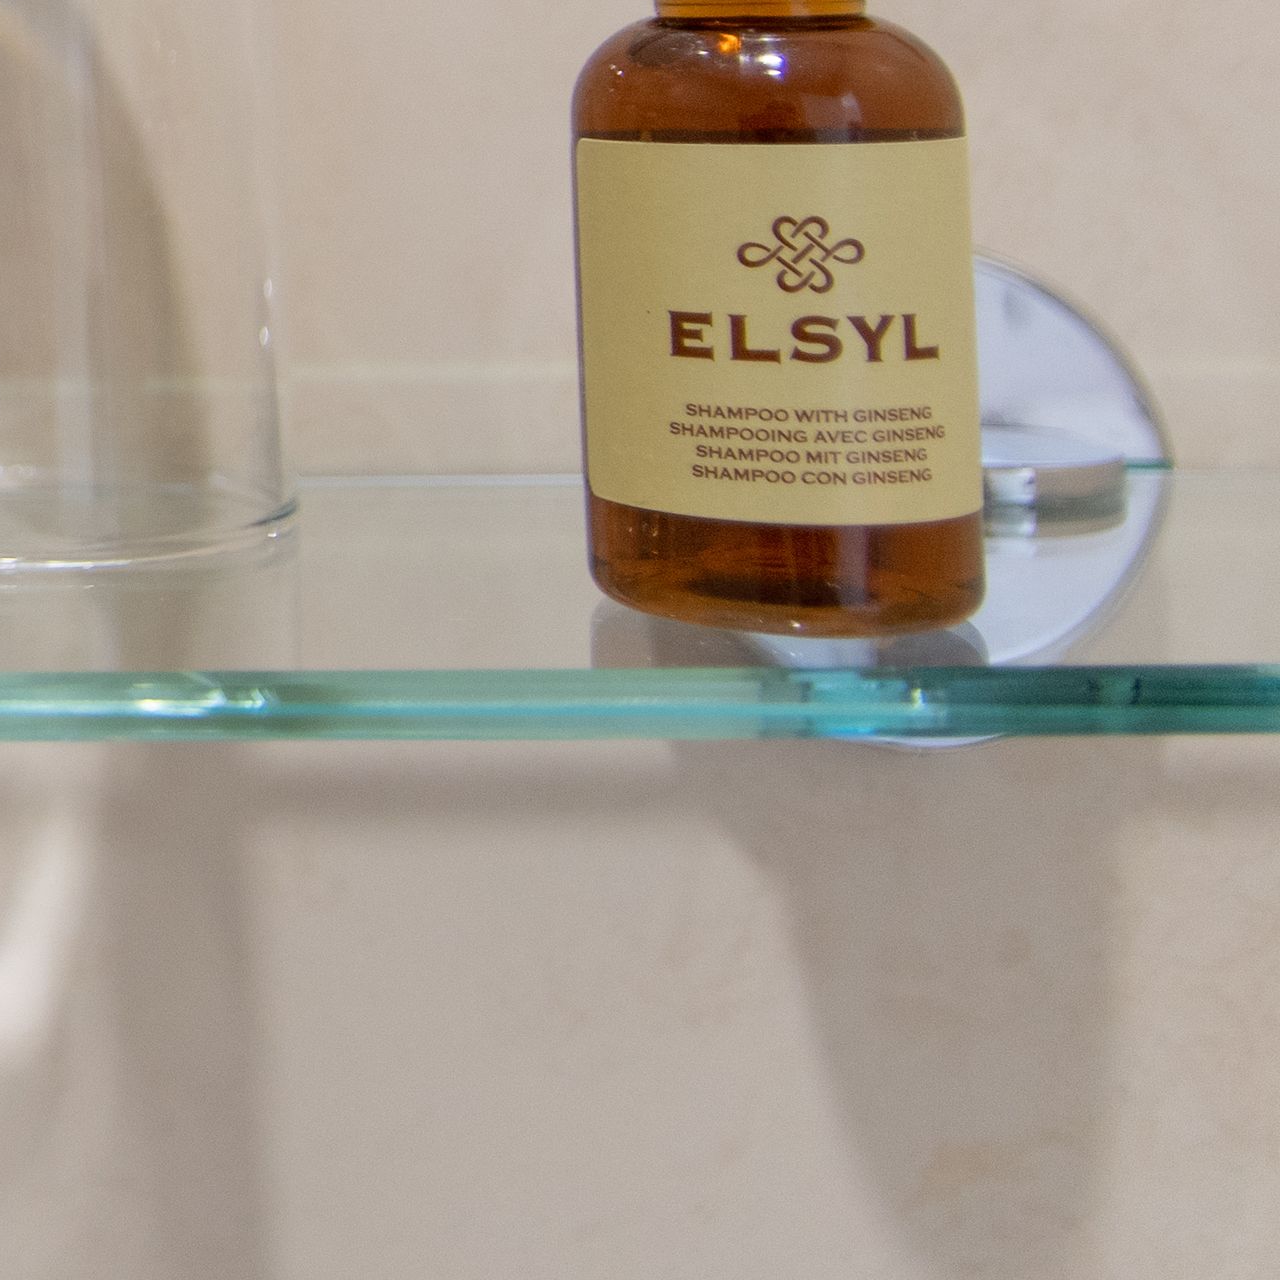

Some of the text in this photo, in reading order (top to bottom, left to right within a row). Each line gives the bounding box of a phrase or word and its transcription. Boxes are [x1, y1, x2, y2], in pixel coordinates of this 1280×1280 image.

[668, 310, 940, 364] ELSYL
[686, 403, 932, 423] SHAMPOO WITH GINSENG
[669, 422, 945, 443] SHAMPOOING AVEC GINSENG
[696, 445, 927, 464] SHAMPOO MIT GINSENG
[692, 465, 932, 484] SHAMPOO CON GINSENG
